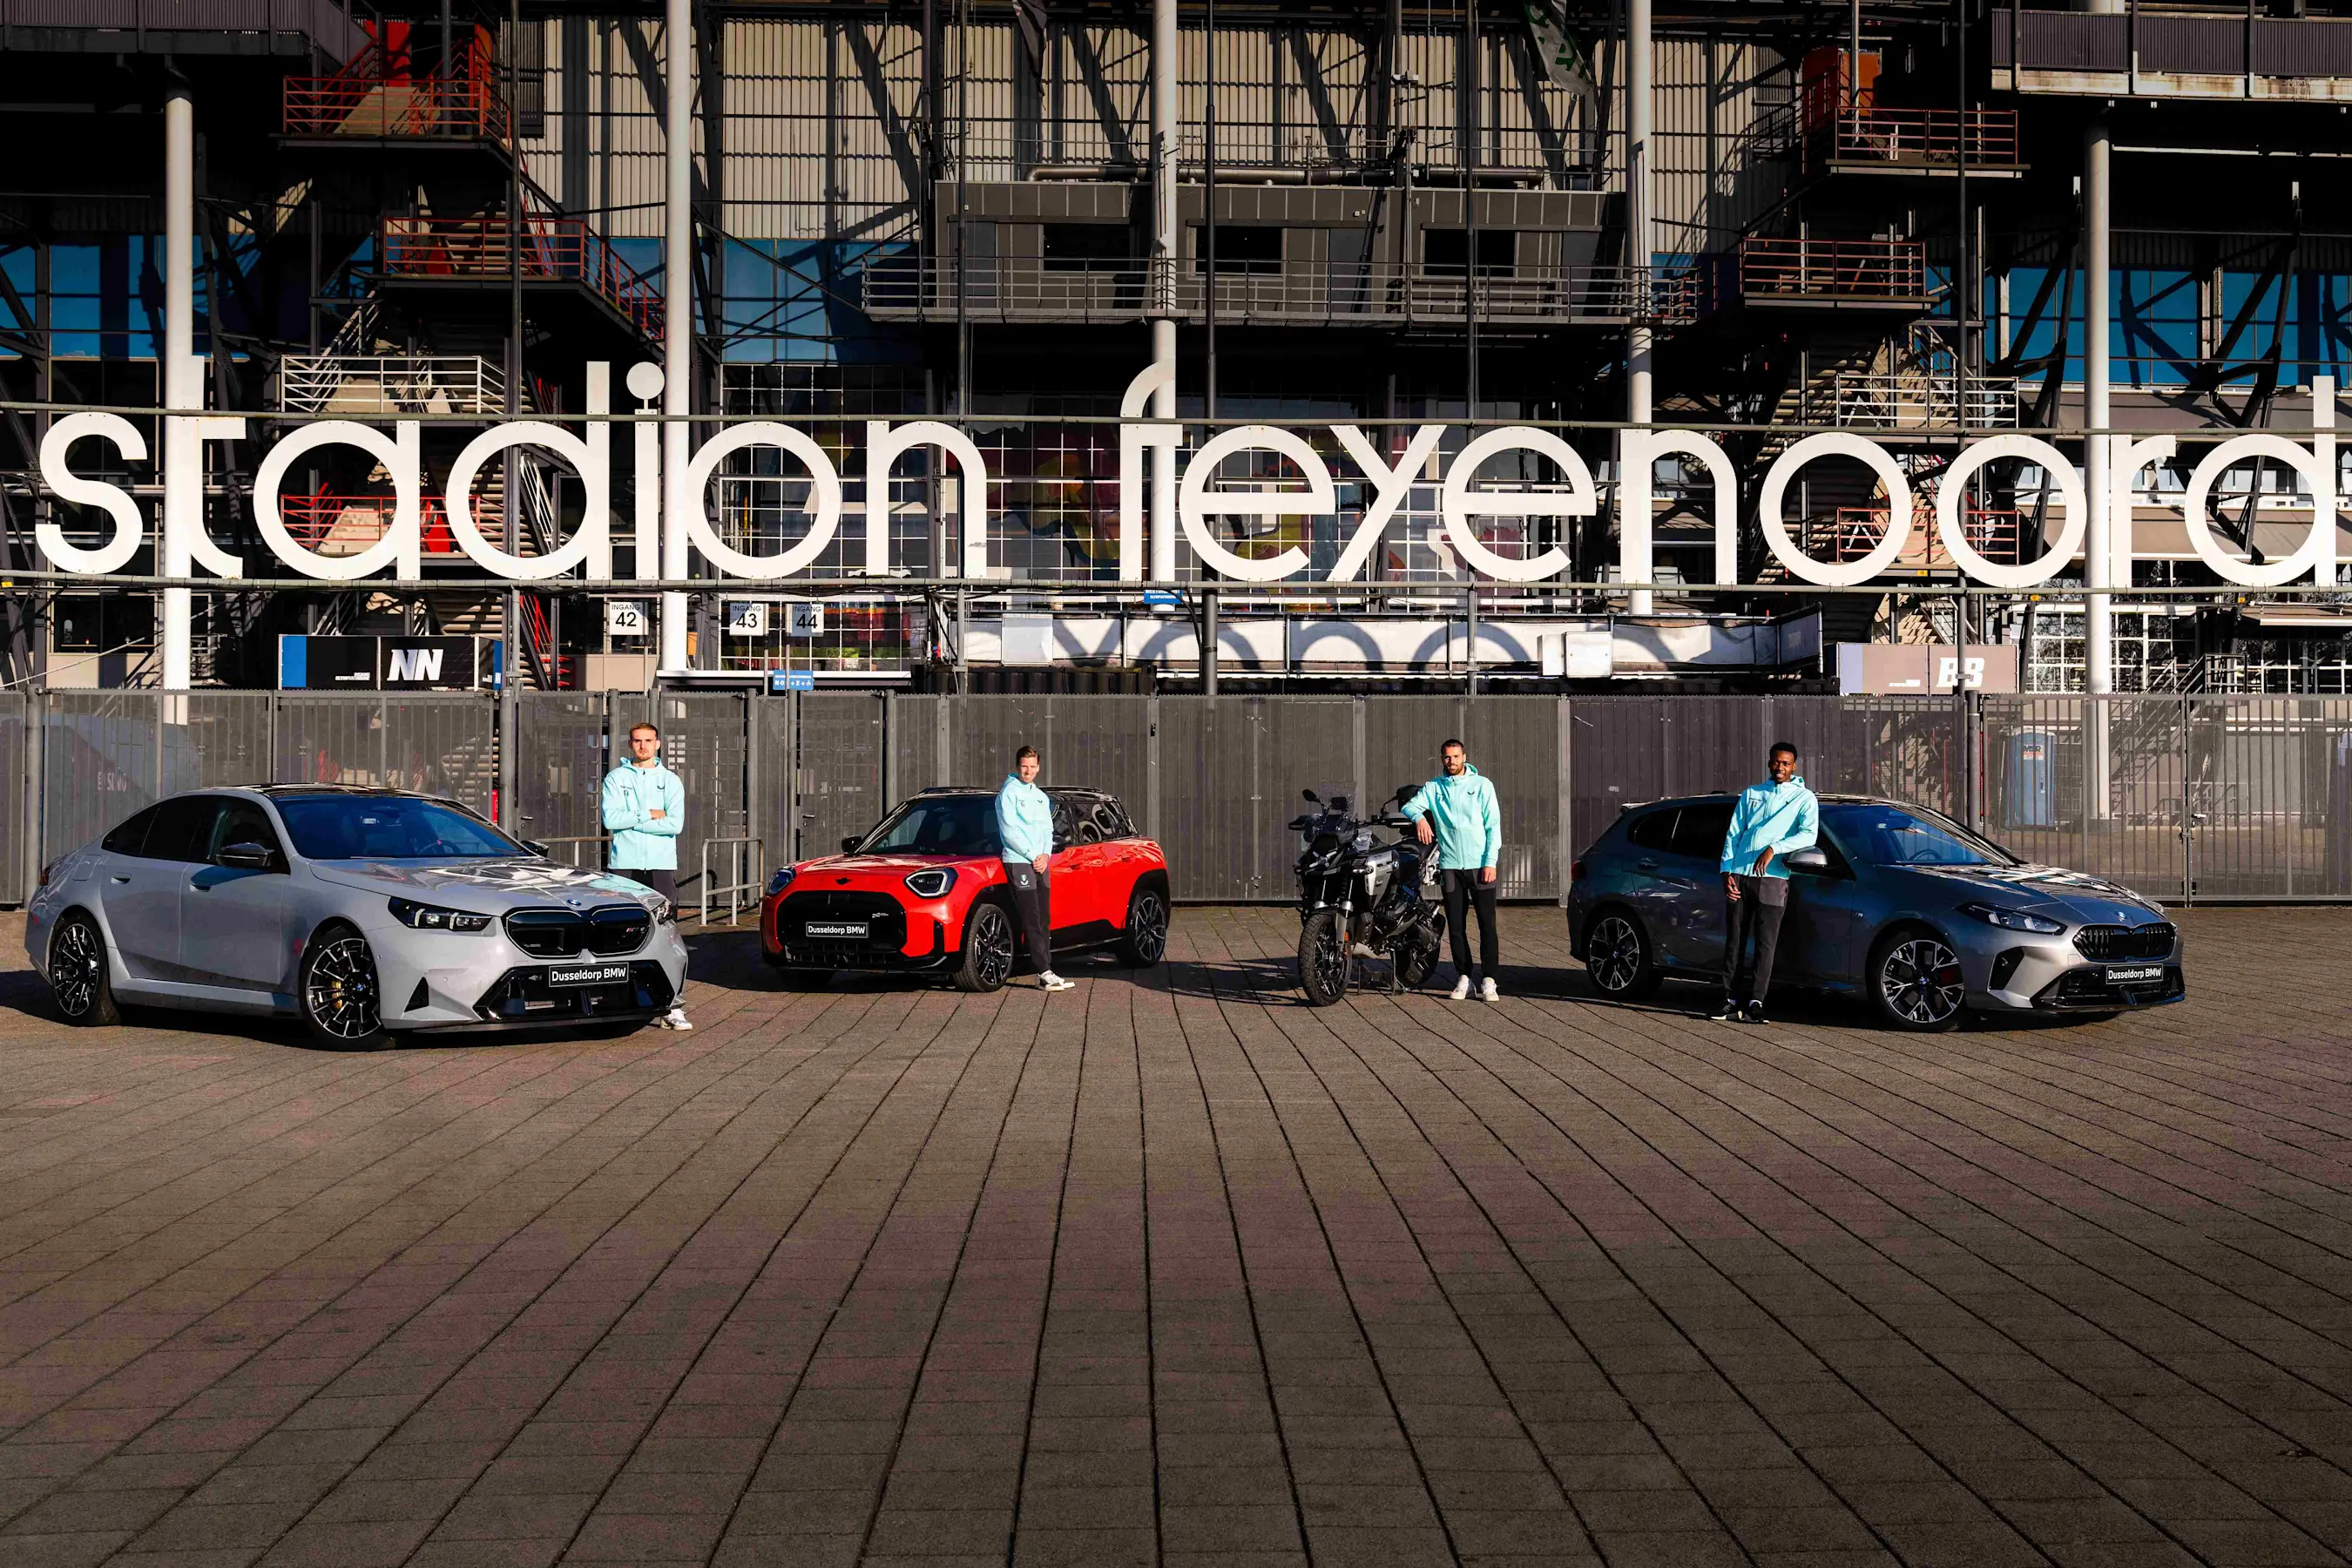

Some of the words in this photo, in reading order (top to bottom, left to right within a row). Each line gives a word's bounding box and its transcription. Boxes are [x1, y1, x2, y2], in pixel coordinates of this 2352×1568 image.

[36, 355, 988, 581] stadion
[1120, 359, 2336, 587] feyenoord
[615, 612, 637, 627] 42
[736, 612, 758, 628] 43
[796, 613, 818, 629] 44
[387, 649, 444, 681] NN
[1936, 657, 1985, 688] BB
[808, 925, 845, 936] Dusseldorp
[846, 925, 866, 935] BMW
[551, 969, 602, 982] Dusseldorp
[603, 967, 626, 978] BMW
[2108, 969, 2145, 980] Dusseldorp
[2145, 968, 2162, 977] BMW
